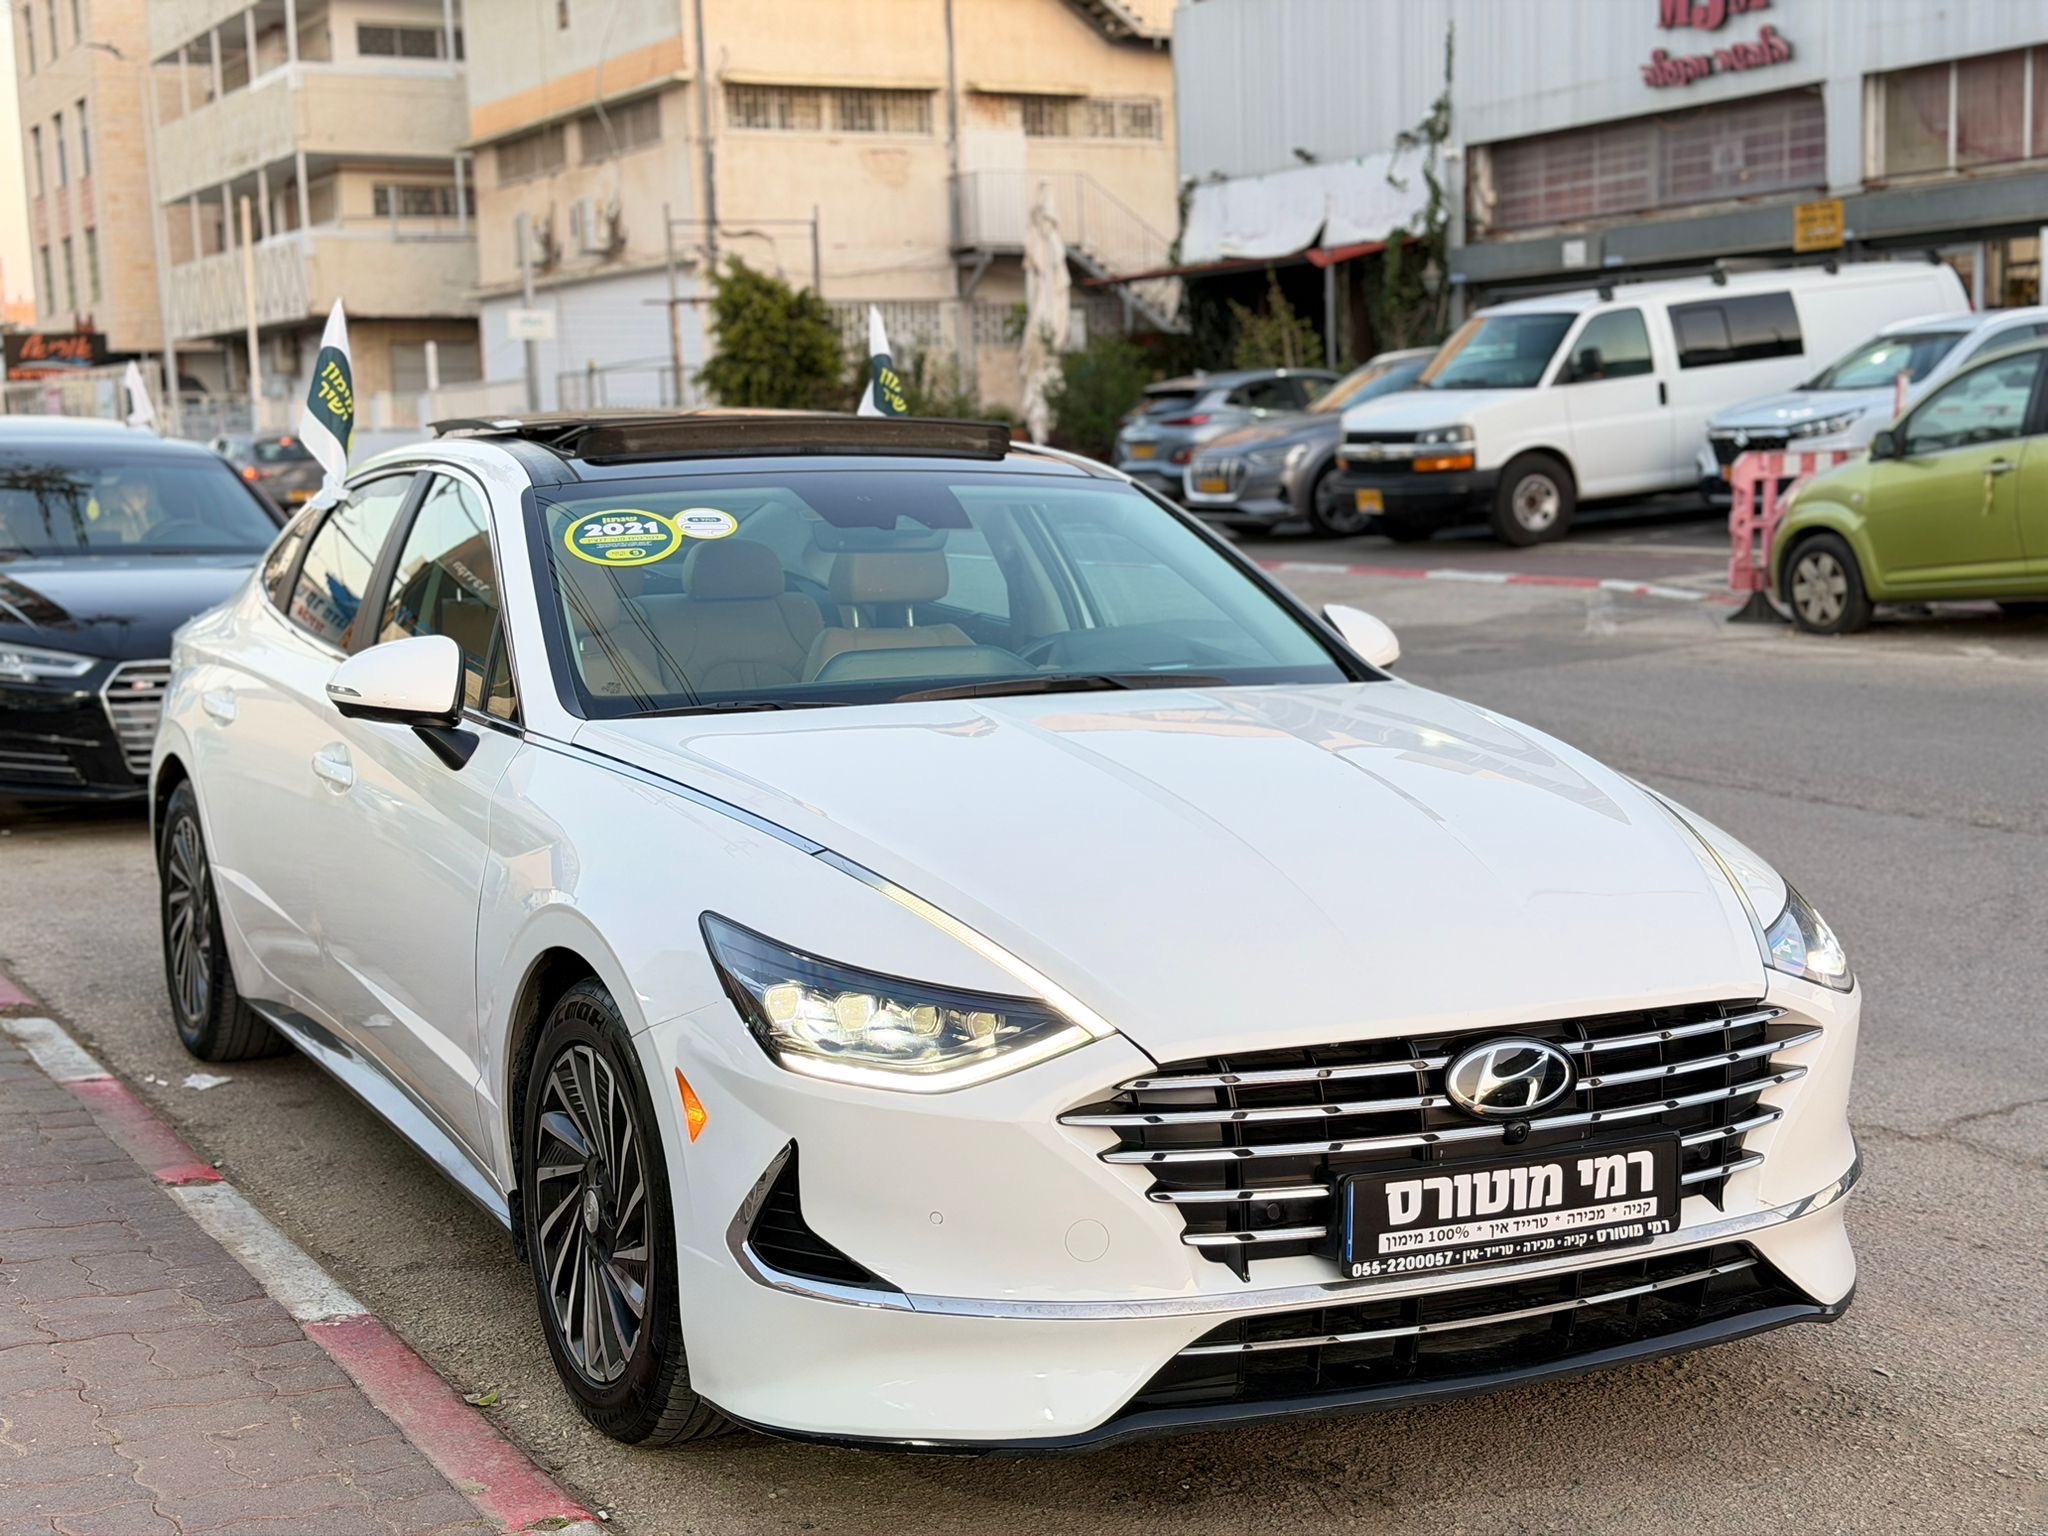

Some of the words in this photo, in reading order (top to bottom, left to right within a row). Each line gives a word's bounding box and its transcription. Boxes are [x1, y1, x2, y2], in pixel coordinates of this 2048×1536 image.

[583, 521, 659, 537] 2021
[1577, 1150, 1654, 1199] רמי
[1385, 1163, 1563, 1226] מוטורס
[1566, 1208, 1606, 1224] מכירה
[1623, 1201, 1651, 1216] קניה
[1488, 1222, 1510, 1238] אין
[1512, 1216, 1549, 1231] טרייד
[1647, 1219, 1671, 1234] רמי
[1428, 1225, 1470, 1243] 100%
[1563, 1233, 1588, 1247] קניה
[1596, 1223, 1644, 1243] מוטורס
[1385, 1232, 1424, 1251] מימון
[1522, 1238, 1556, 1253] מכירה
[1351, 1250, 1455, 1278] 055-2200057
